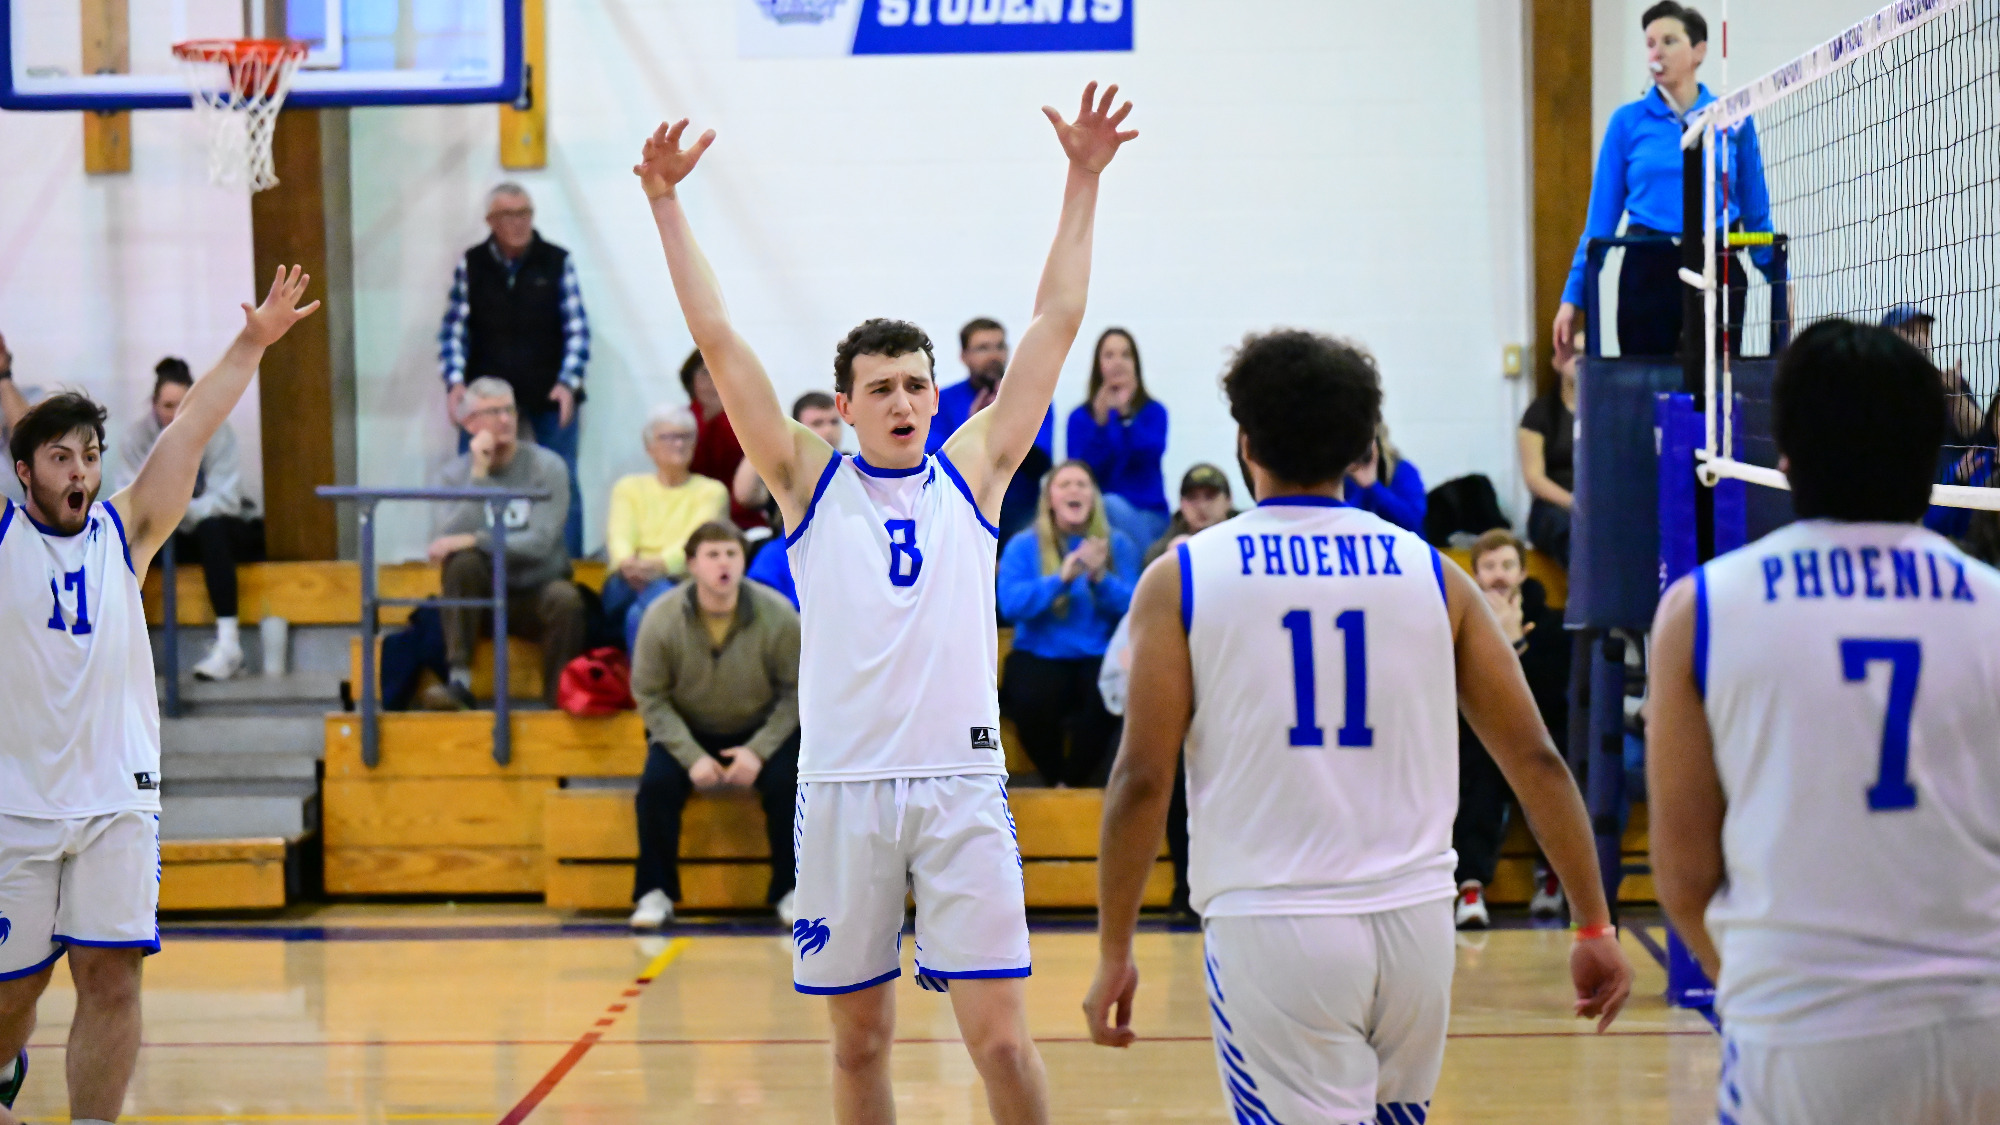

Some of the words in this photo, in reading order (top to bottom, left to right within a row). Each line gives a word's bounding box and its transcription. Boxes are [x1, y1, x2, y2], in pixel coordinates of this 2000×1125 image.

[884, 519, 923, 587] 8
[1236, 534, 1402, 576] PHOENIX
[1761, 547, 1975, 602] PHOENIX
[47, 565, 92, 635] 17
[1281, 609, 1374, 747] 11
[1838, 638, 1922, 812] 7
